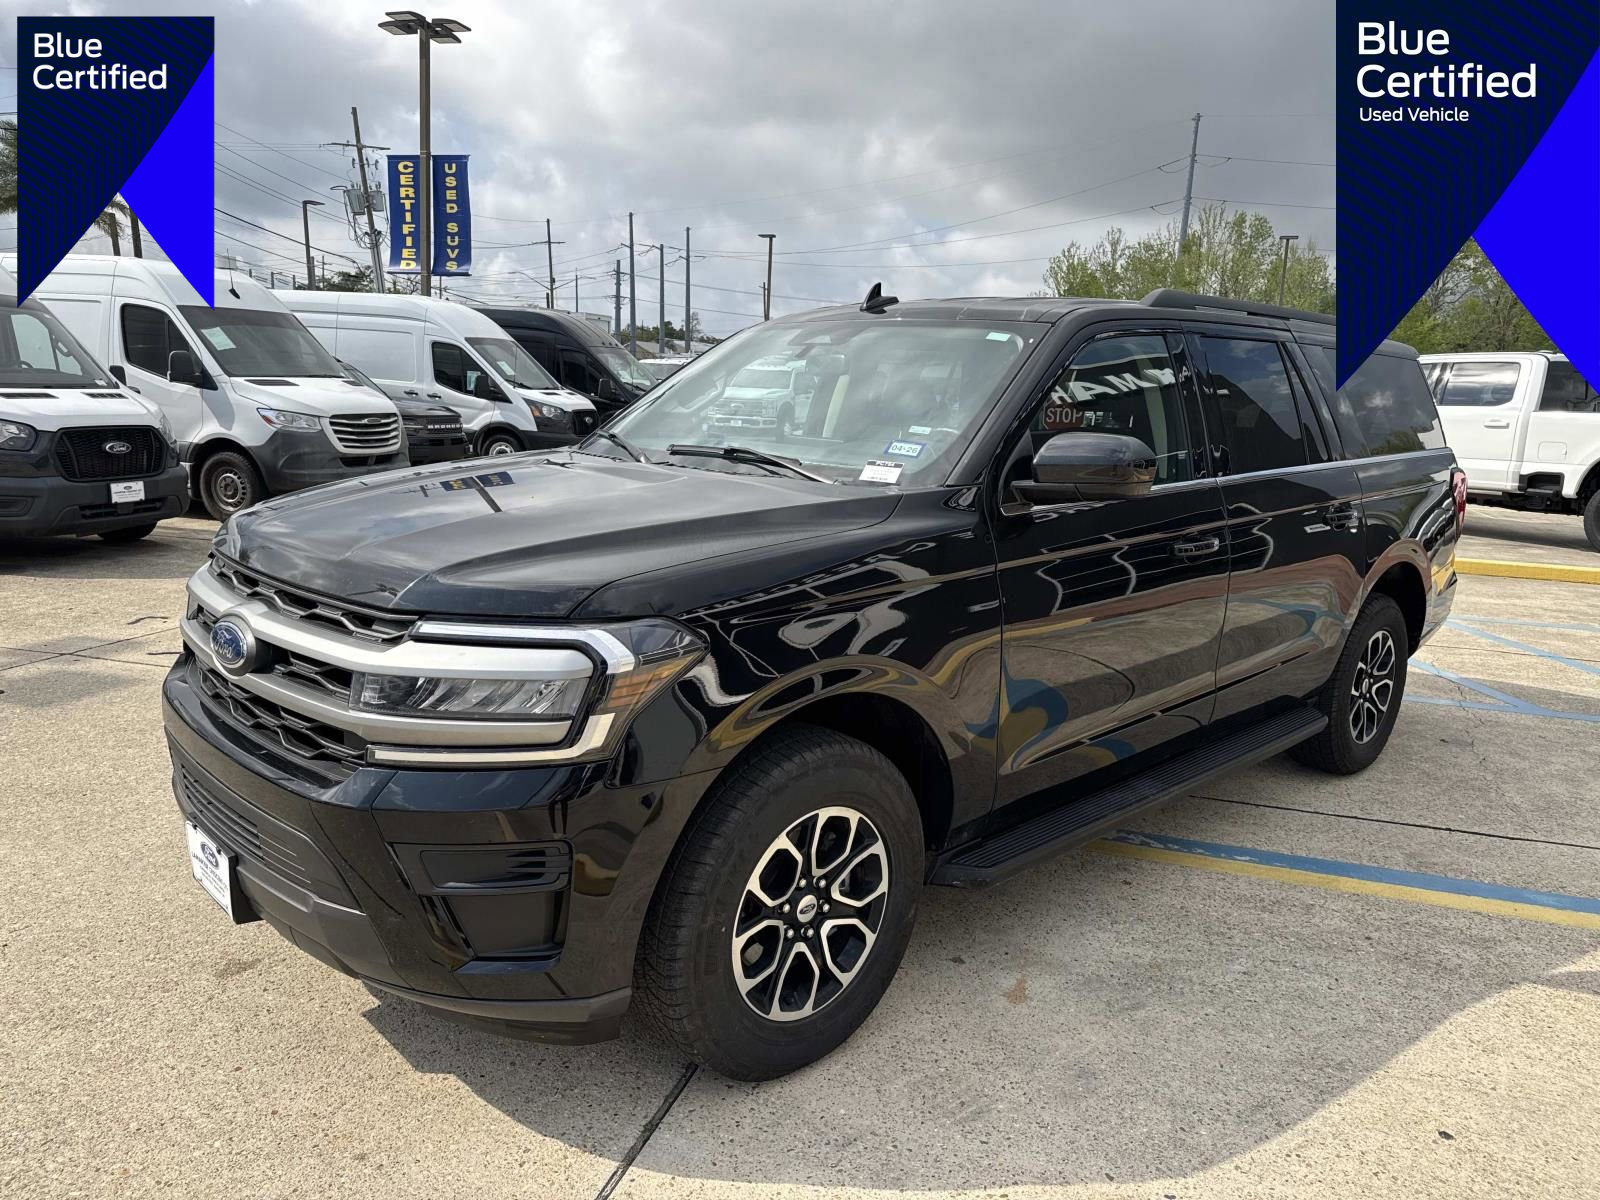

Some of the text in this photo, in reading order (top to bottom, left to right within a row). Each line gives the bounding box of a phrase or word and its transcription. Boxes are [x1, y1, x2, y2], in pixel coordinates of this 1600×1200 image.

[397, 161, 417, 270] CERTIFIED
[444, 163, 460, 271] USED SUVS
[1046, 407, 1082, 424] STOP
[212, 626, 239, 660] Ford
